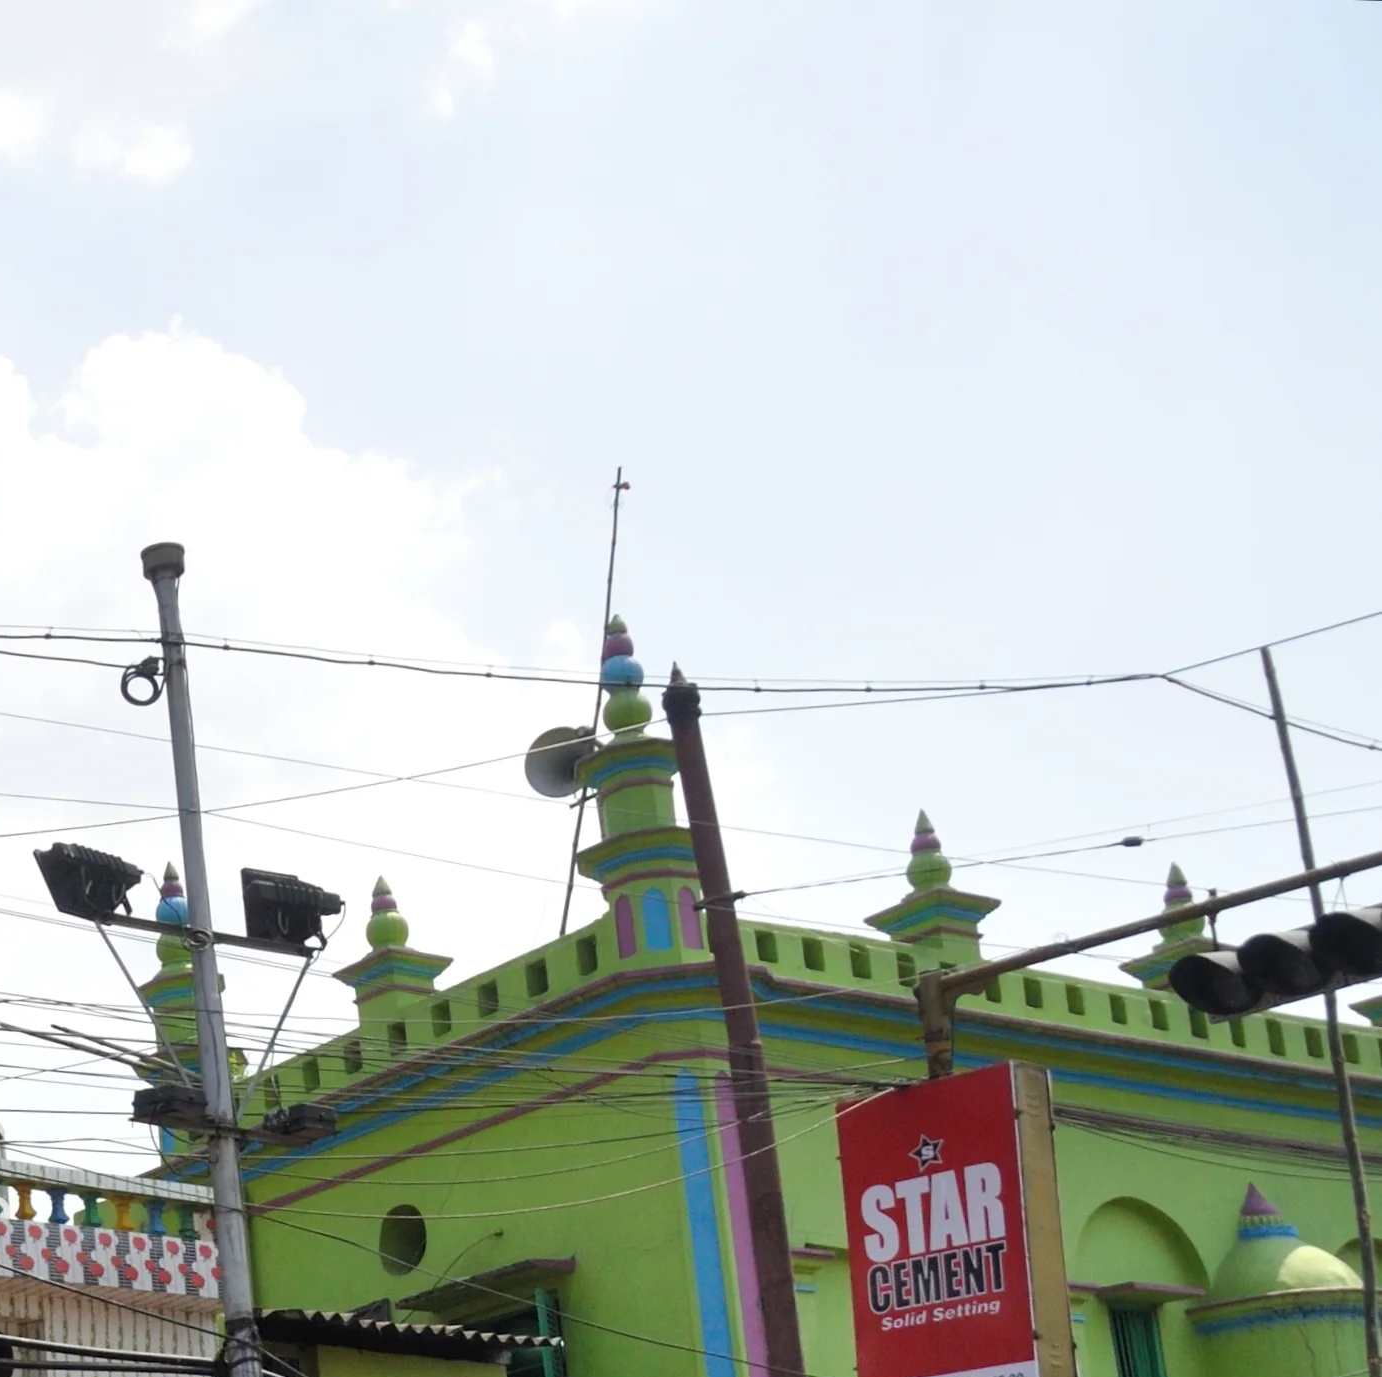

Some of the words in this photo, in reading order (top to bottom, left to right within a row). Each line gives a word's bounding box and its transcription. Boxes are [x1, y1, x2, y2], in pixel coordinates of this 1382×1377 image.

[861, 1162, 1006, 1263] STAR
[867, 1240, 1007, 1315] CEMENT
[881, 1311, 927, 1331] Solid
[932, 1300, 1000, 1323] Setting
